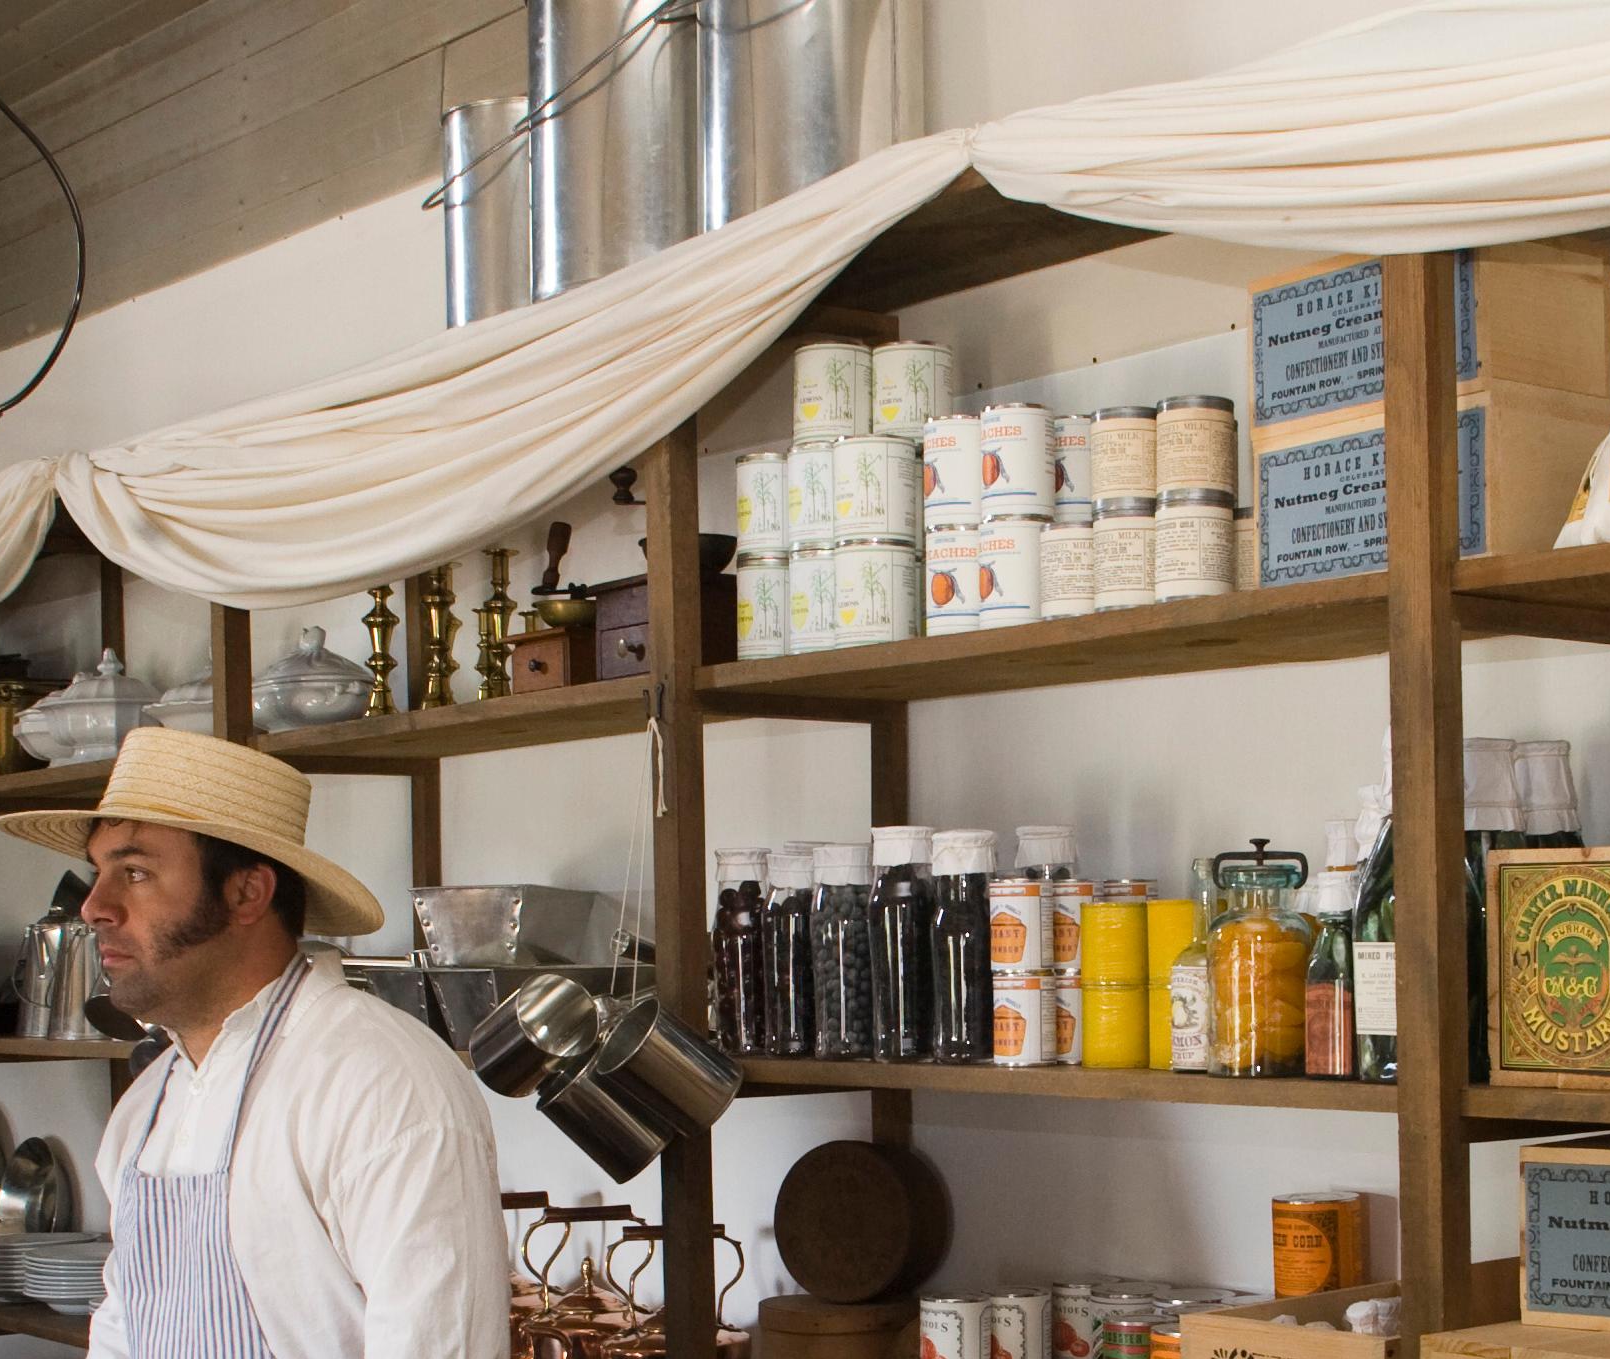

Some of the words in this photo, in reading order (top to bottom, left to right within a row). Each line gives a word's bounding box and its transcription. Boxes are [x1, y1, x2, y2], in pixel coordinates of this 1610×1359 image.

[1297, 287, 1354, 317] HORACE
[1267, 323, 1331, 348] Nutmeg
[1318, 330, 1369, 349] MANUFACTURED
[1285, 351, 1349, 381] CONFECTIONERY
[1352, 345, 1369, 363] AND
[1271, 383, 1316, 400] FOUNTAIN
[1303, 453, 1361, 481] HORACE
[1274, 488, 1338, 510] Nutmeg
[1325, 499, 1378, 515] MANUFACTURED
[1291, 514, 1356, 545] CONFECTIONERY
[1358, 510, 1376, 531] AND
[1277, 545, 1323, 563] FOUNTAIN
[1516, 882, 1563, 943] CARTER
[1562, 878, 1610, 906] MANN
[1552, 922, 1596, 940] DURHAM
[1293, 1235, 1322, 1248] CORN
